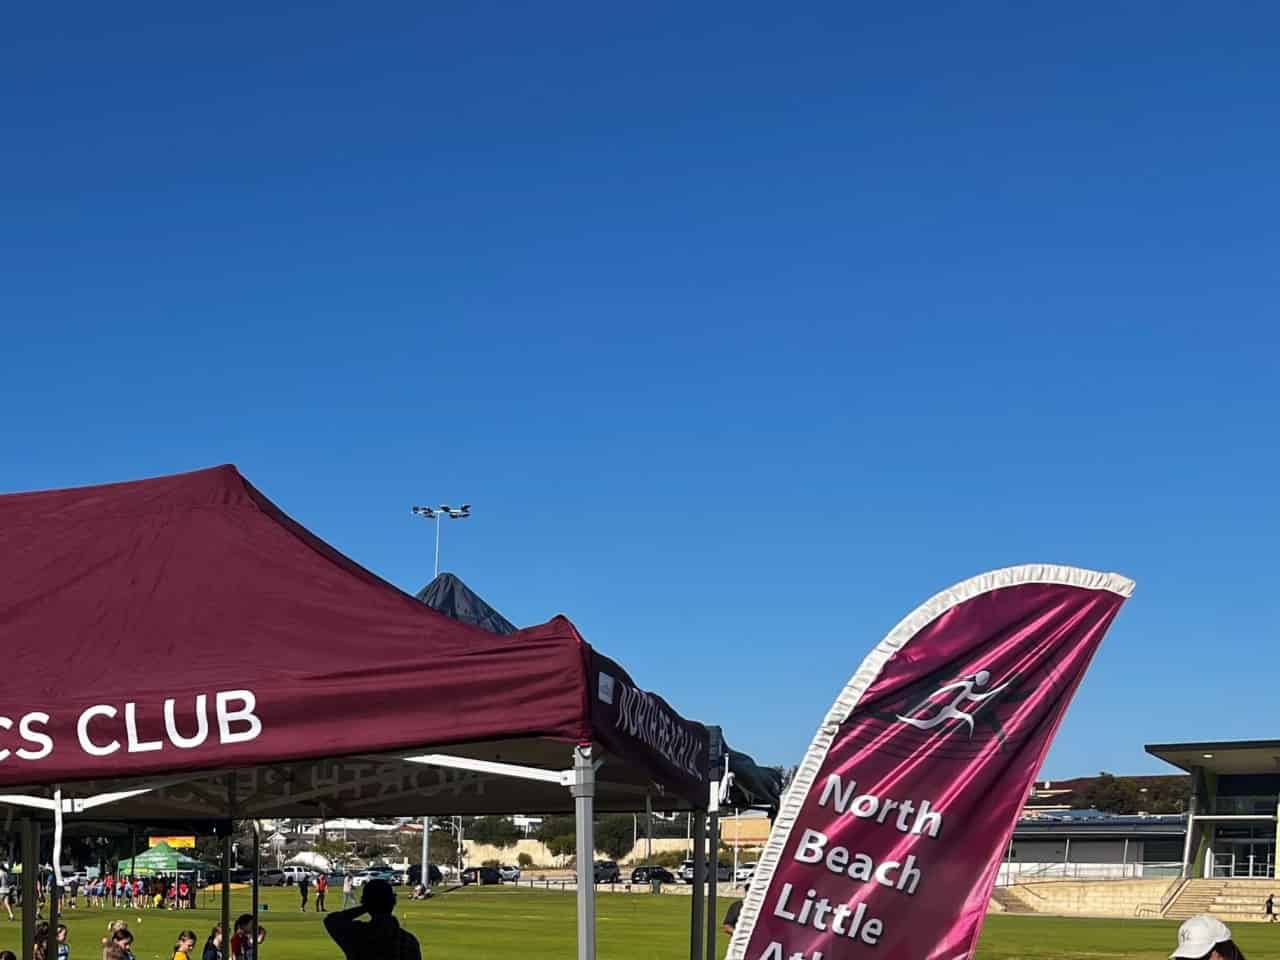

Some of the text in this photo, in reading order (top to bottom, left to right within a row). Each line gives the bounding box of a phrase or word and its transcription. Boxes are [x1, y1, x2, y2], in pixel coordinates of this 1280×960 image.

[76, 689, 264, 757] CLUB
[817, 773, 944, 839] North
[793, 828, 922, 895] Beach
[773, 882, 884, 945] Little
